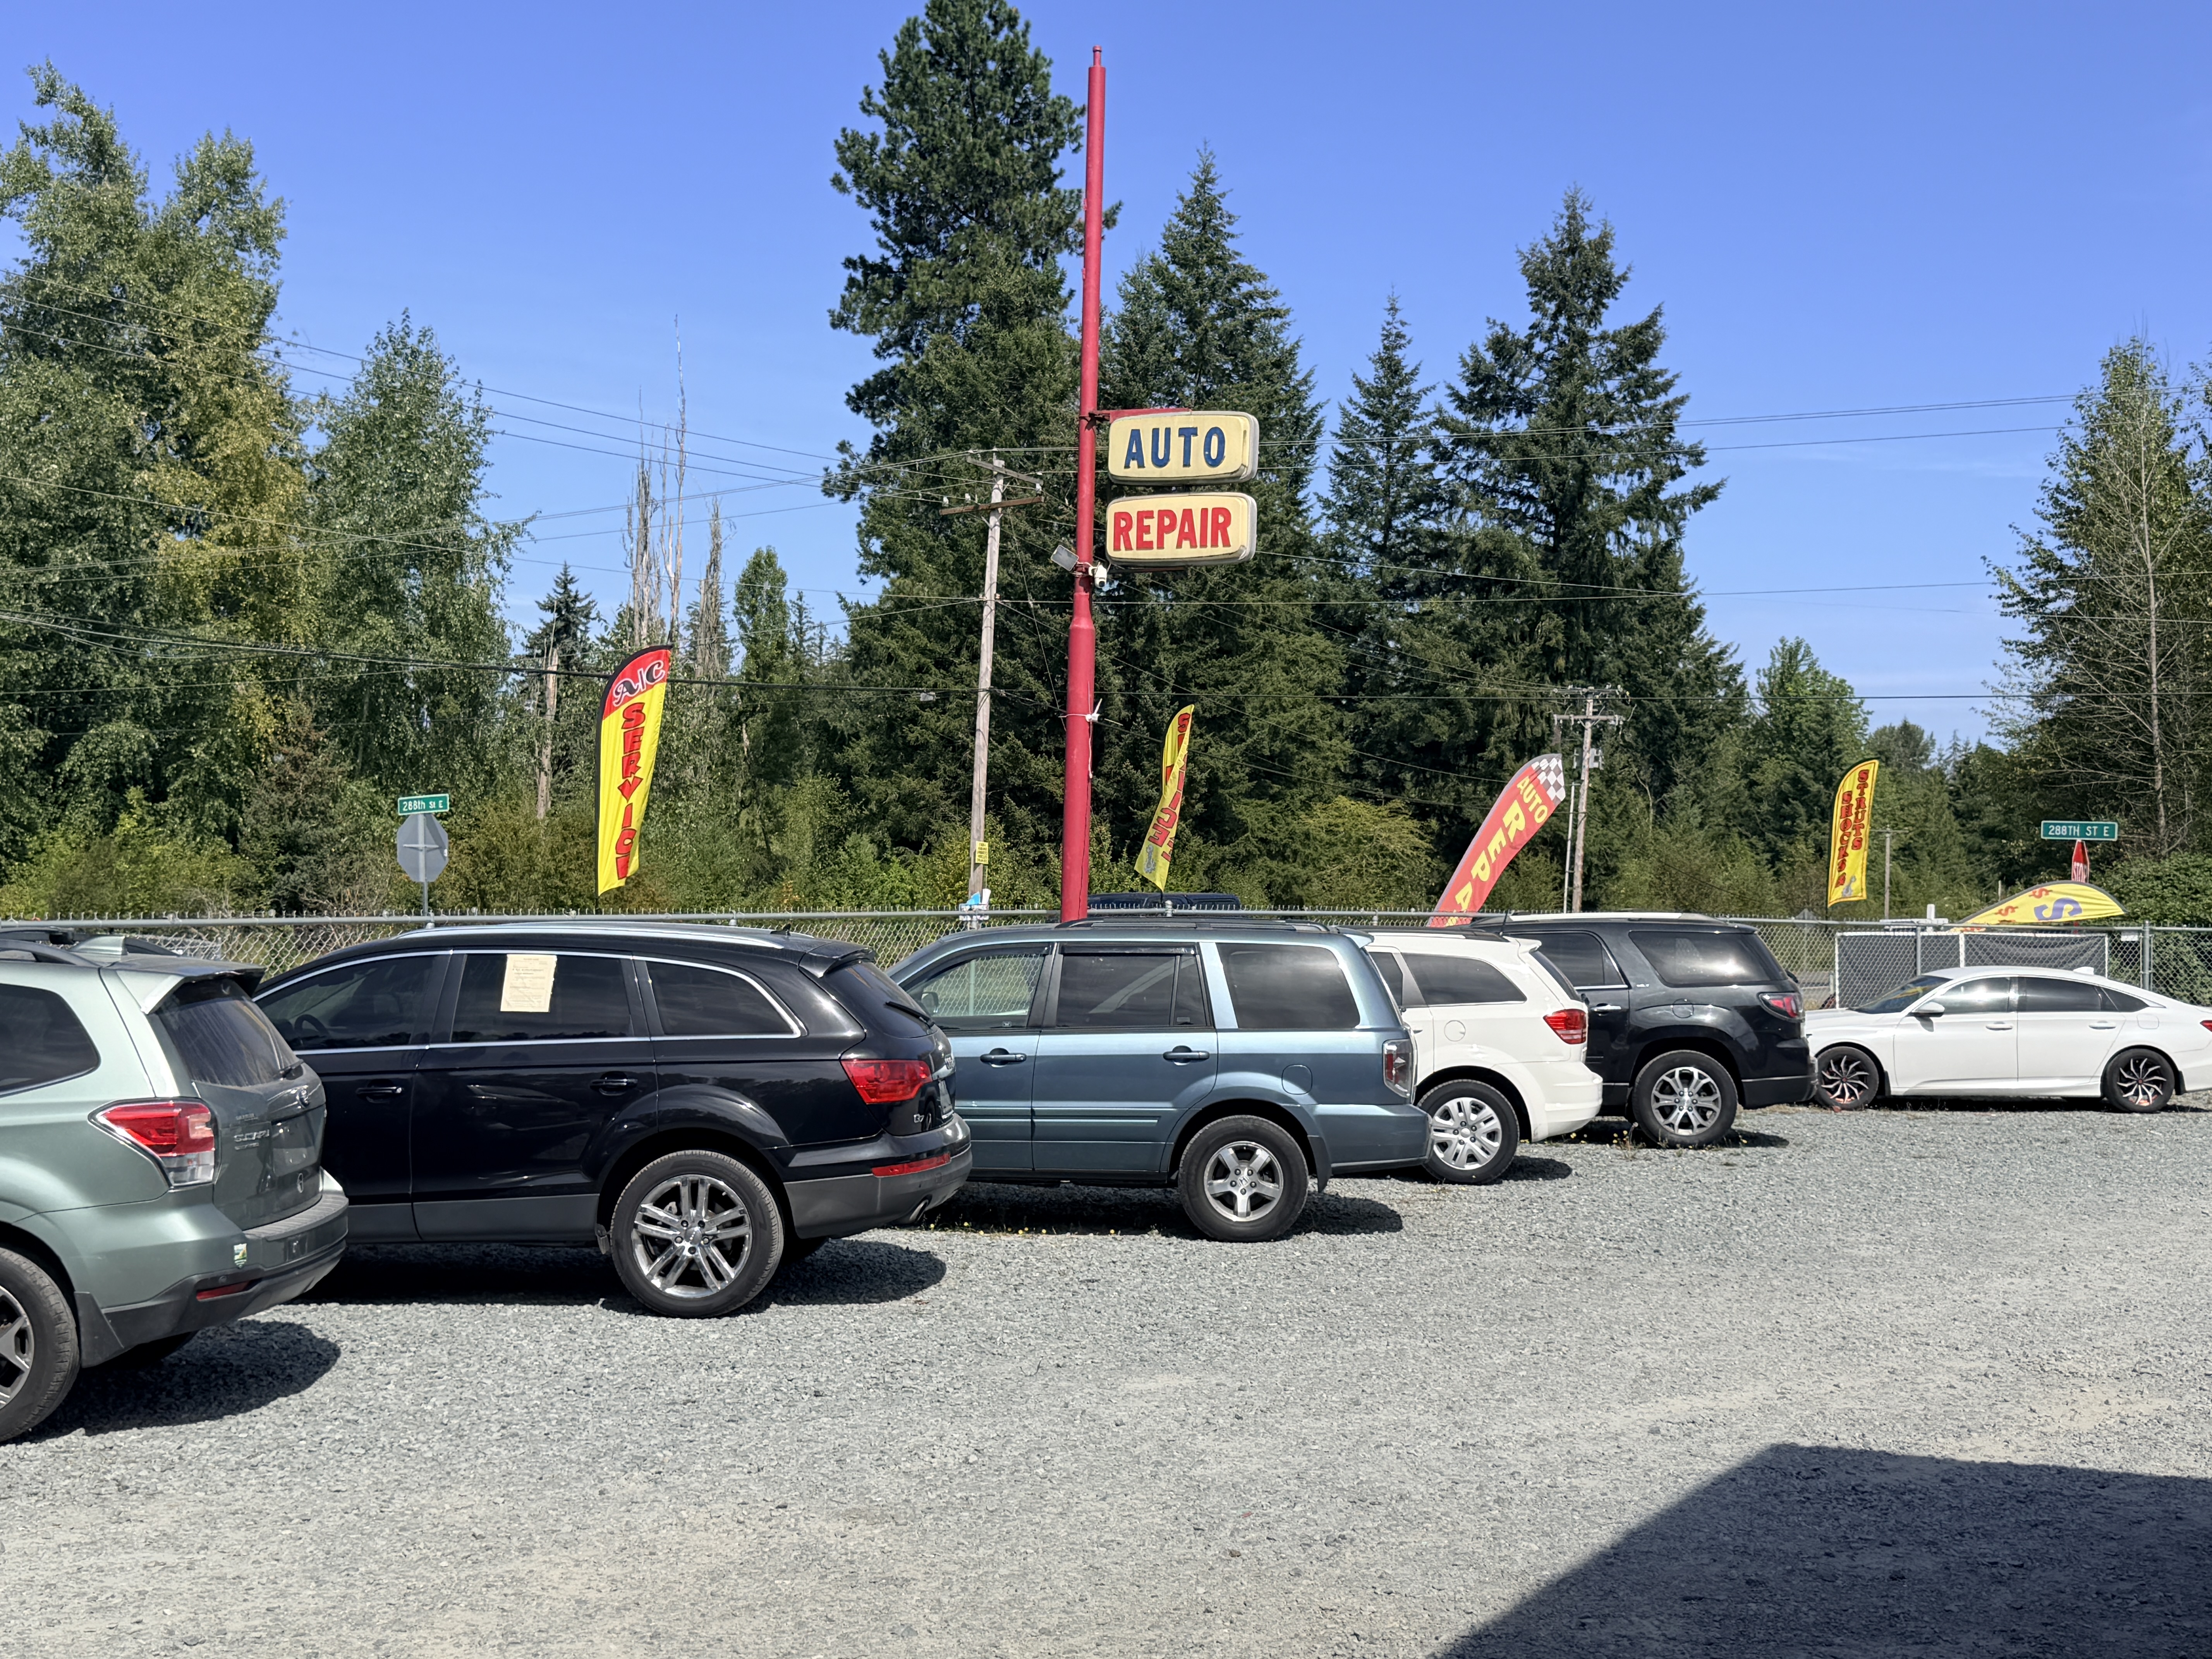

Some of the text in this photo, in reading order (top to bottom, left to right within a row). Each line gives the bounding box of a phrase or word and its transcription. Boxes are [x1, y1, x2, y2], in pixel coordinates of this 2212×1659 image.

[1124, 426, 1226, 469] AUTO
[1113, 507, 1231, 551] REPAIR
[402, 800, 426, 811] 288th
[438, 800, 443, 808] E
[1516, 776, 1548, 824] AUTO
[1851, 769, 1869, 850] STRUTS
[2048, 825, 2110, 836] 288TH ST E
